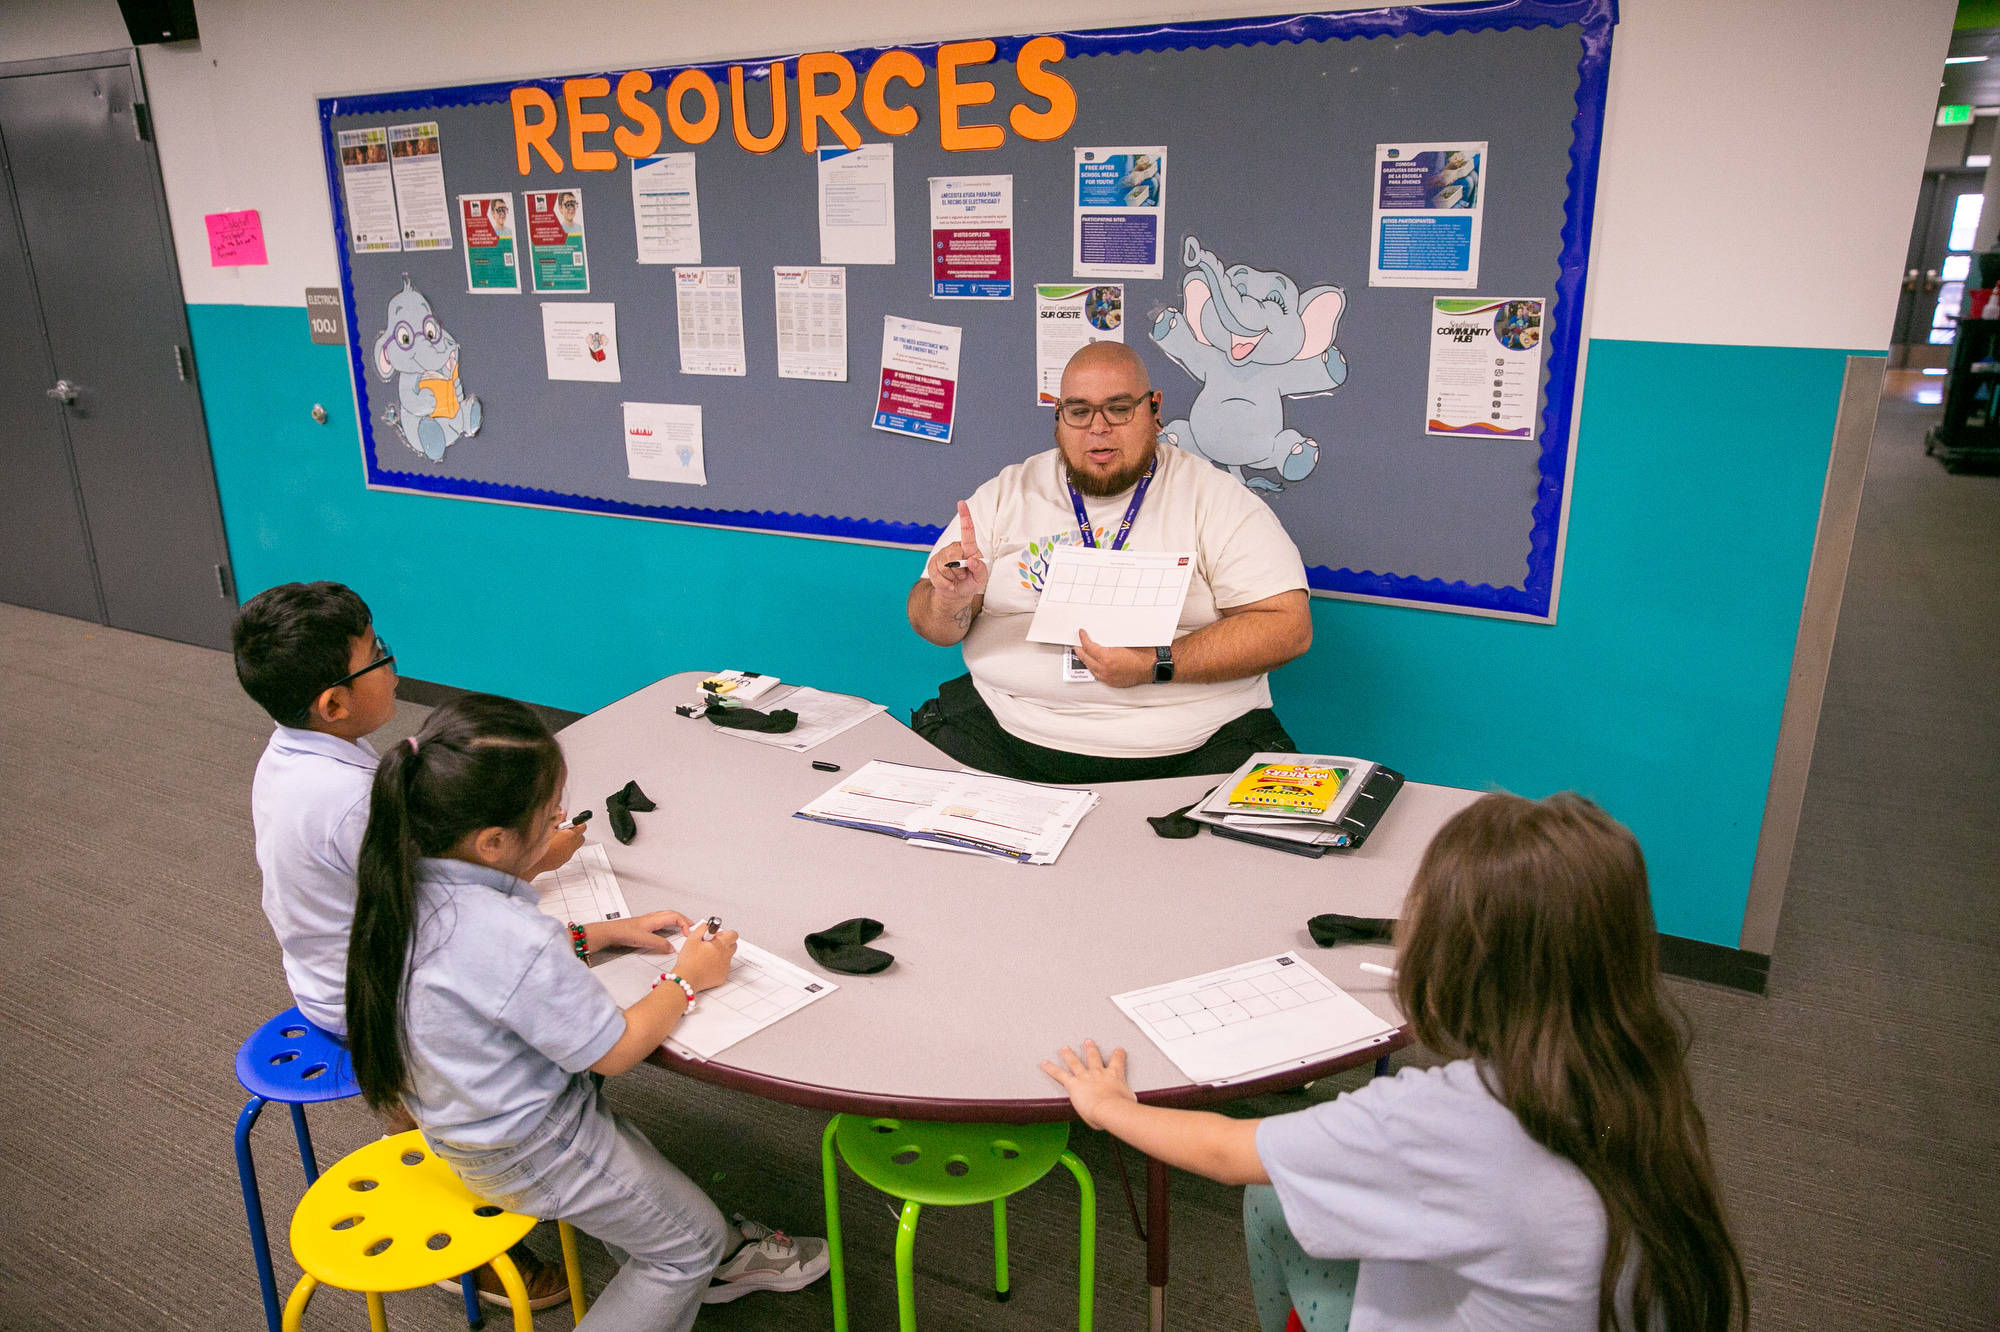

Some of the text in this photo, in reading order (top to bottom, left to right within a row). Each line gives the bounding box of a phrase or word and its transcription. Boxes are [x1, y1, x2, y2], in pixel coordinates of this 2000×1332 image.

[510, 37, 1077, 176] RESOURCES
[308, 295, 339, 305] ELECTRICAL
[1041, 311, 1081, 319] SUR OESTE
[311, 319, 337, 333] 100J
[1437, 328, 1491, 336] COMMUNITY
[1453, 335, 1473, 343] HUB
[1264, 769, 1329, 779] MARKERS
